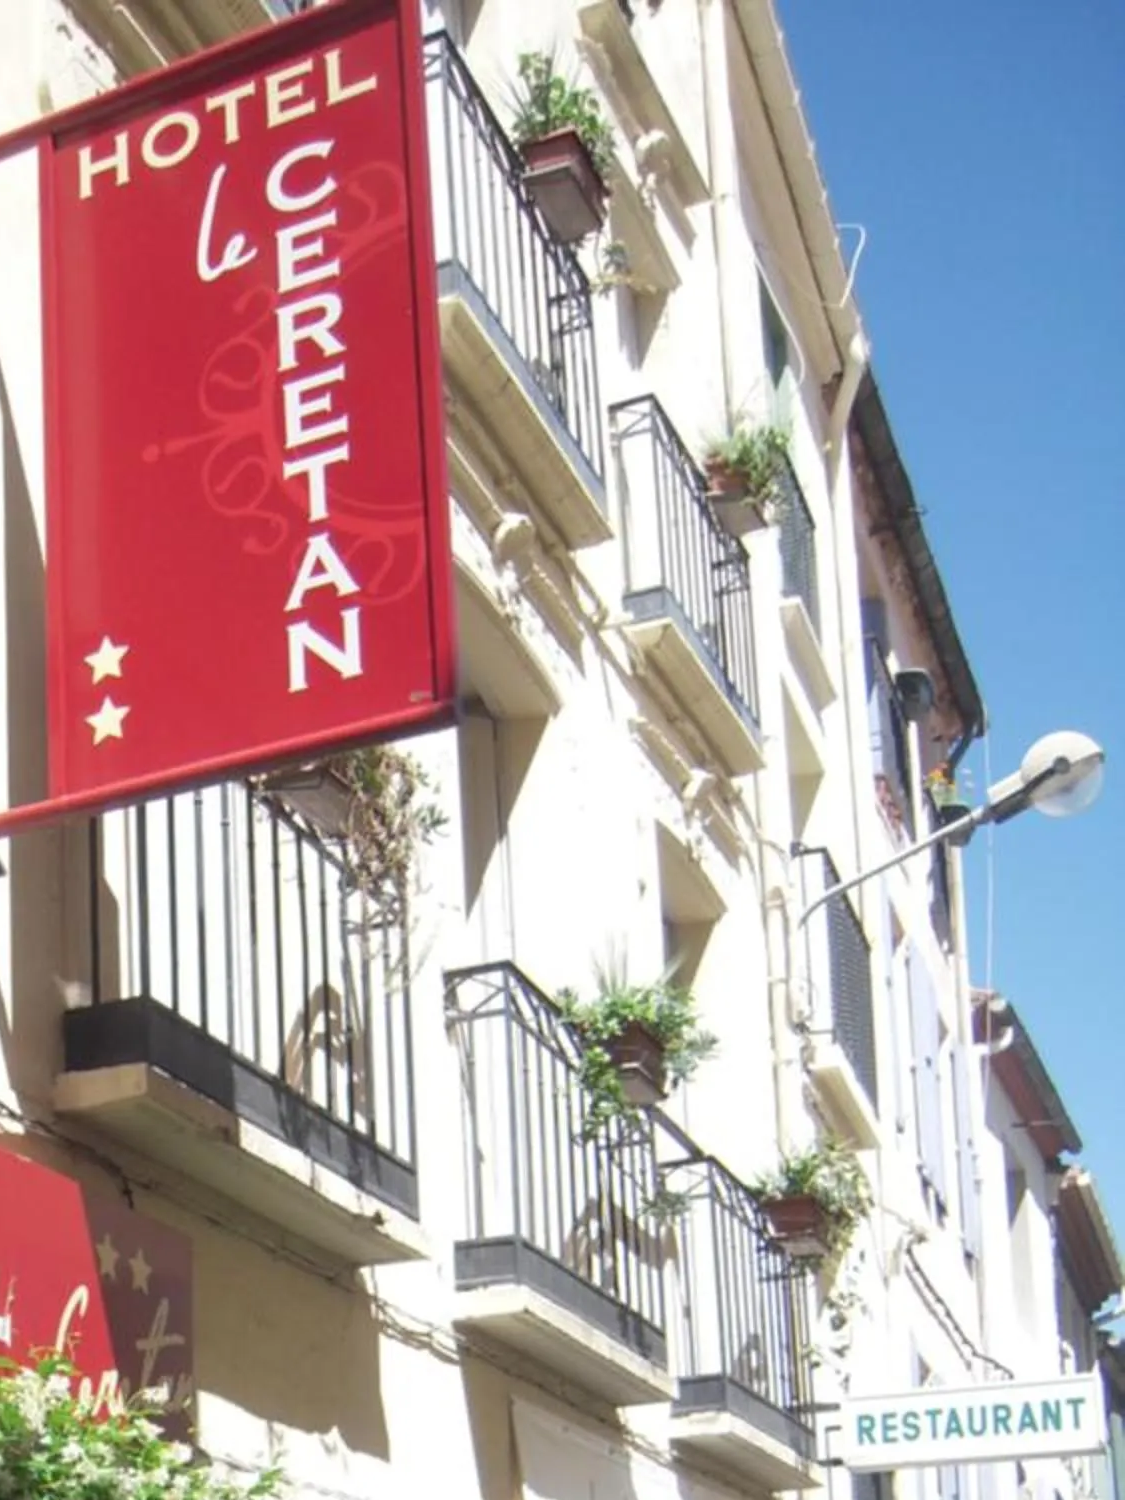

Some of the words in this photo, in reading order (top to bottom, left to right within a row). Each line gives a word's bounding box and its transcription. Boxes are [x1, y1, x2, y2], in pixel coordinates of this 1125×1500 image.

[78, 48, 378, 200] HOTEL
[196, 163, 258, 282] le
[266, 138, 363, 693] CERETAN
[856, 1397, 1086, 1446] RESTAURANT
